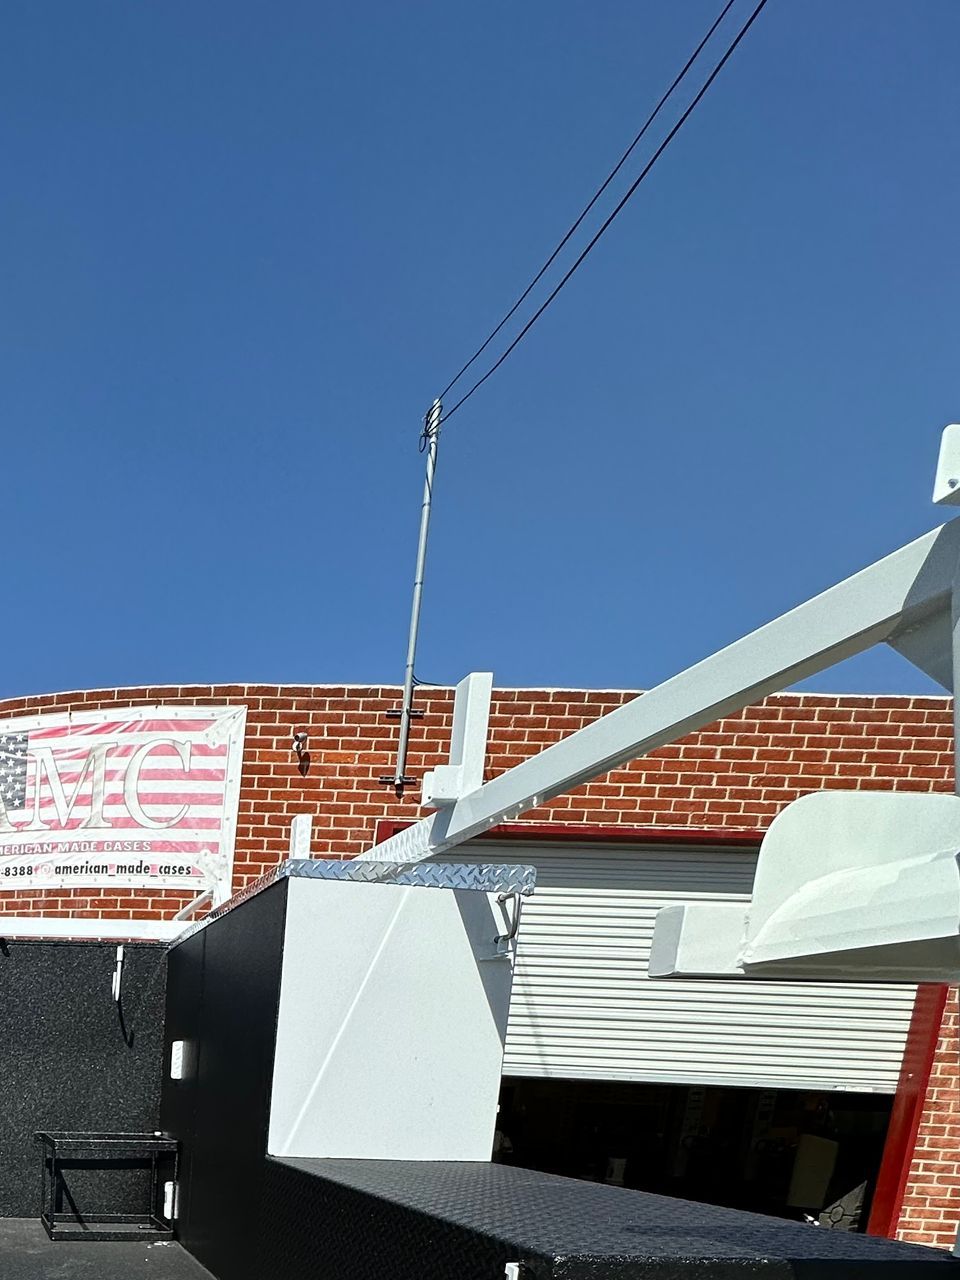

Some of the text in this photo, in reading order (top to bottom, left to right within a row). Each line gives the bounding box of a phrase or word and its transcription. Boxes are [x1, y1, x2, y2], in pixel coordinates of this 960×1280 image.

[56, 841, 98, 853] MADE
[103, 840, 152, 852] CASES
[54, 860, 192, 878] american_made_cases
